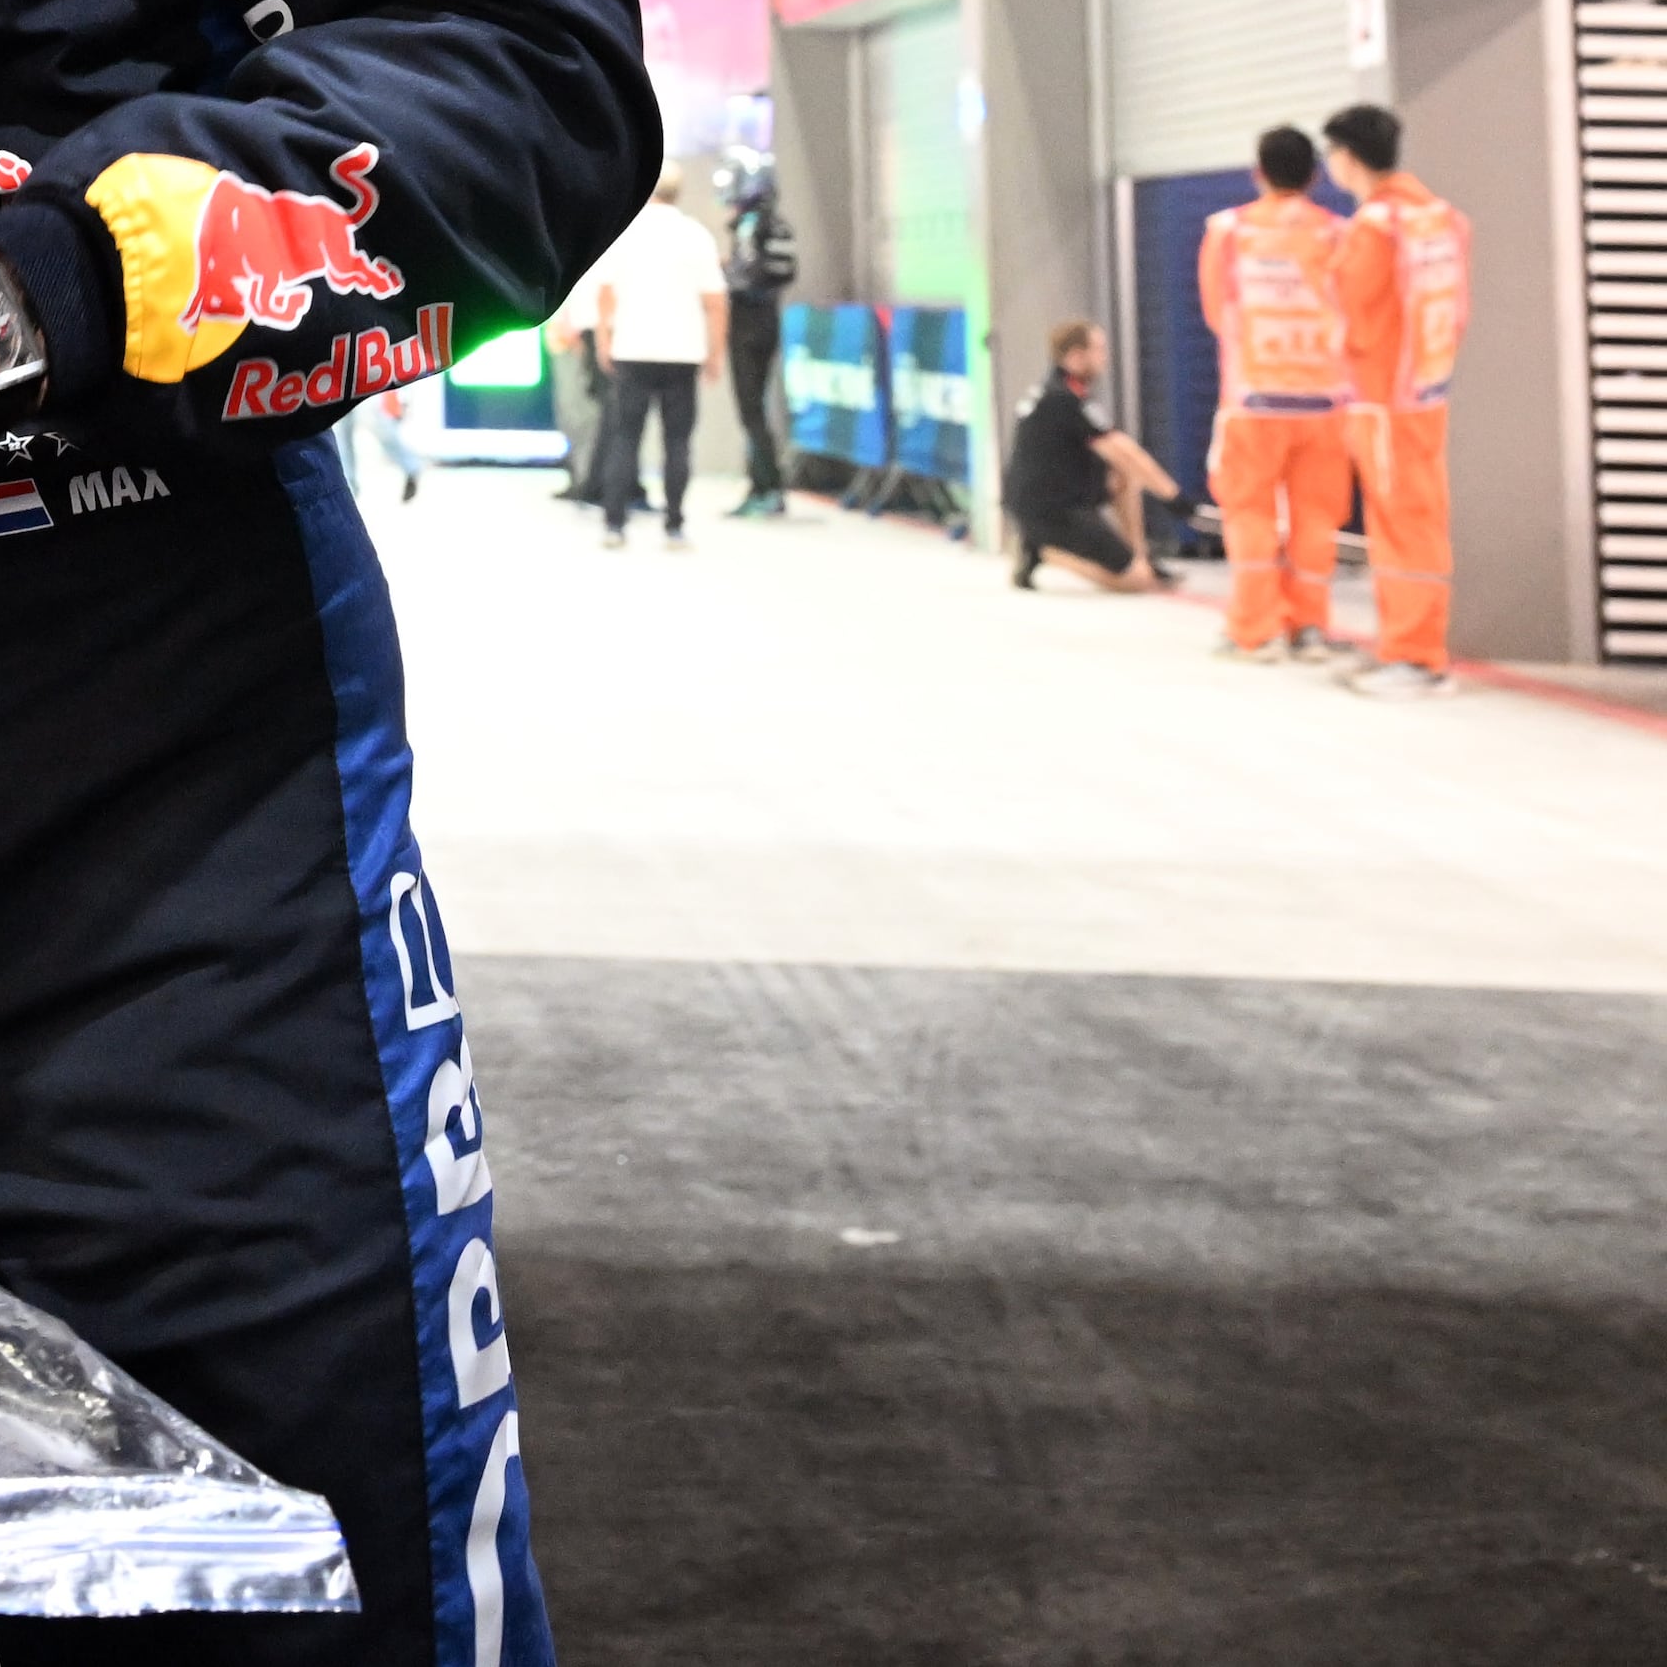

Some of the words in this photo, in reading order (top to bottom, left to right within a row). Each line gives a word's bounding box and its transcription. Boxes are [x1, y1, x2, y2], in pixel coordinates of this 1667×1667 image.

[225, 336, 348, 418] Red
[354, 304, 452, 396] Bull
[69, 466, 171, 515] MAX
